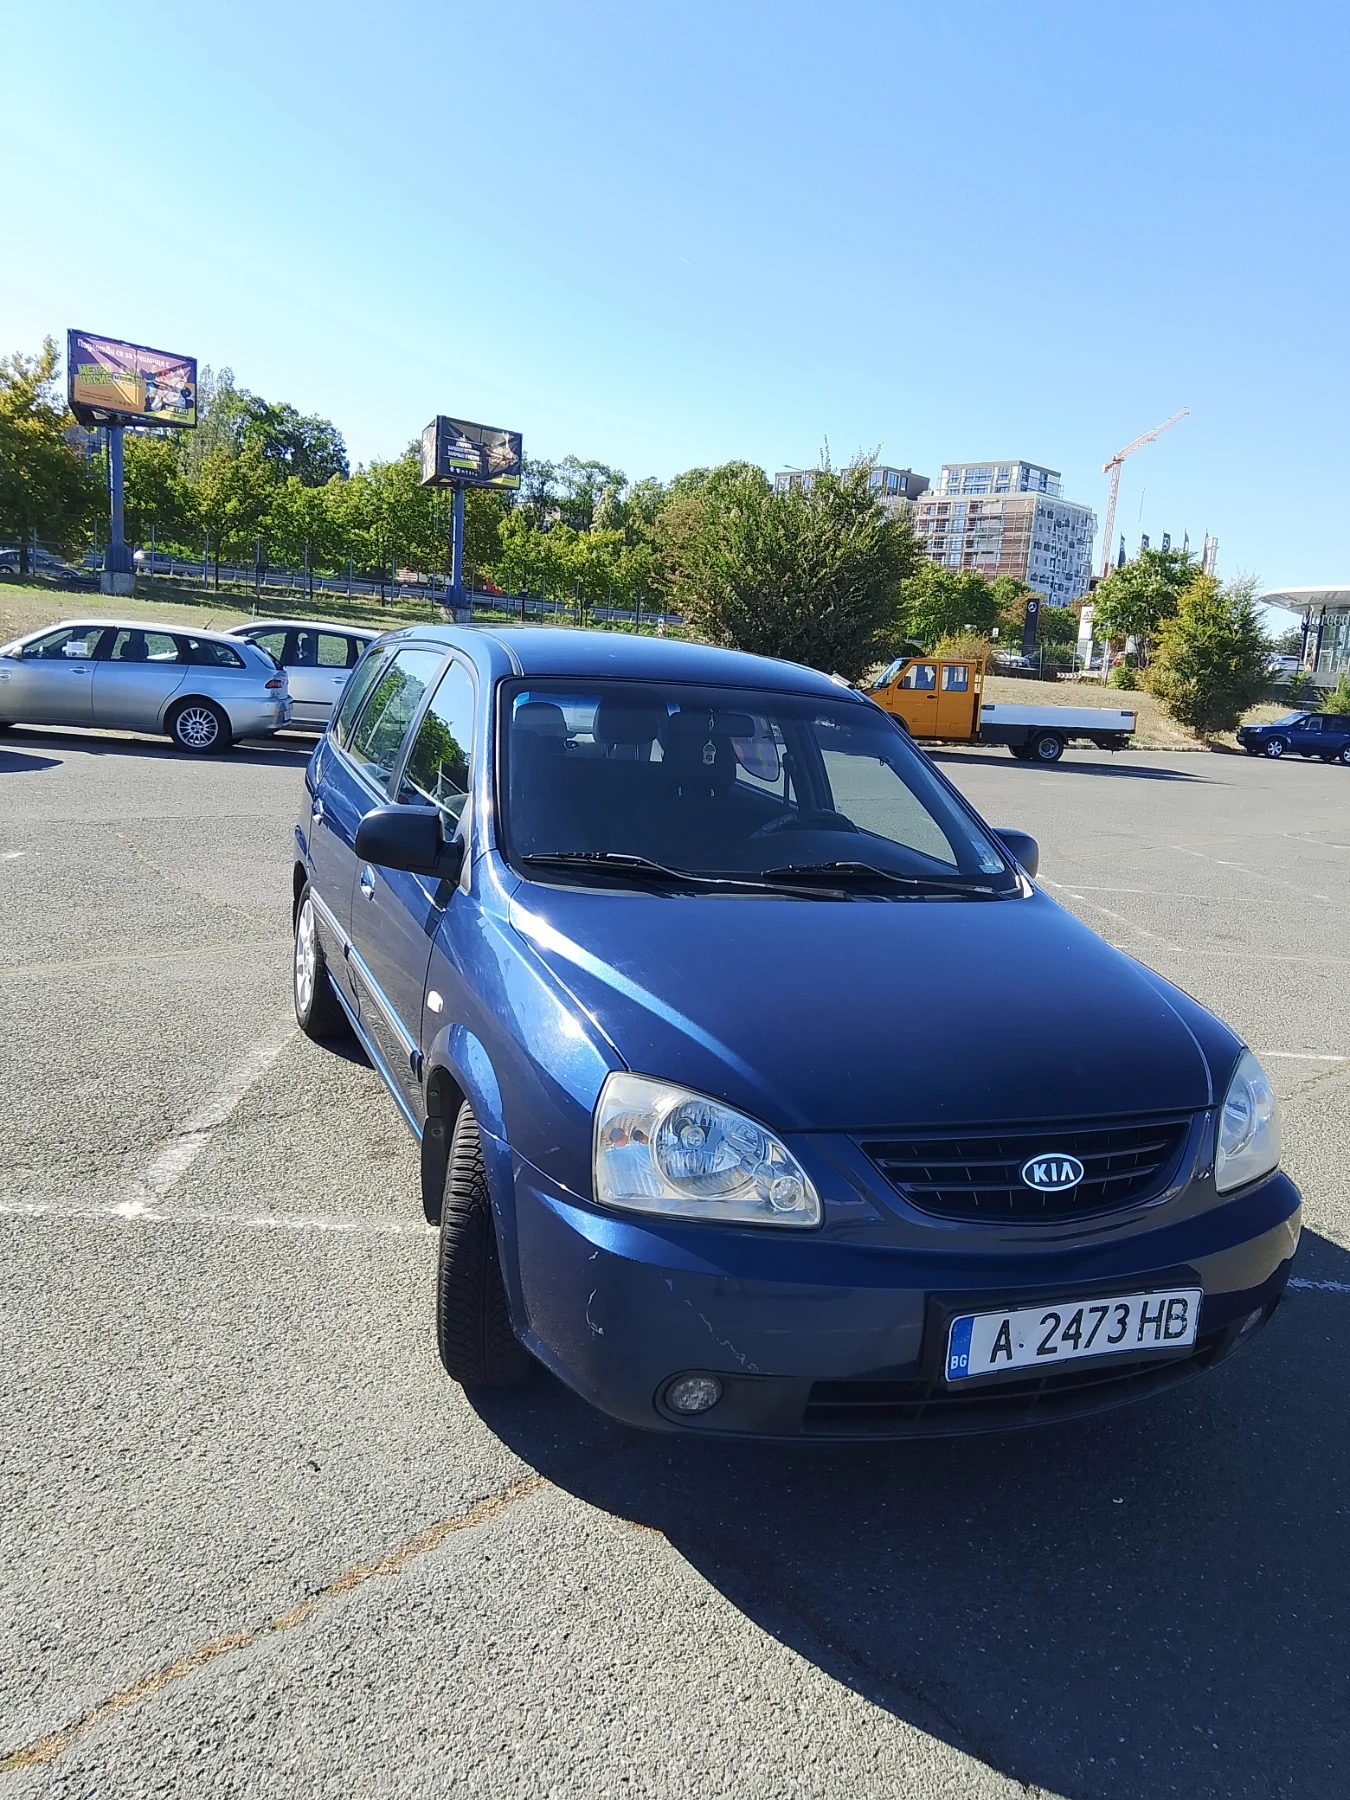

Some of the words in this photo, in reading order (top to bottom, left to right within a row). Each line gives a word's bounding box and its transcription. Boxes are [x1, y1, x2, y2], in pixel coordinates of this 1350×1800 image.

[1033, 1162, 1075, 1183] KIA
[1036, 1304, 1130, 1356] 2473
[950, 1355, 968, 1369] BG
